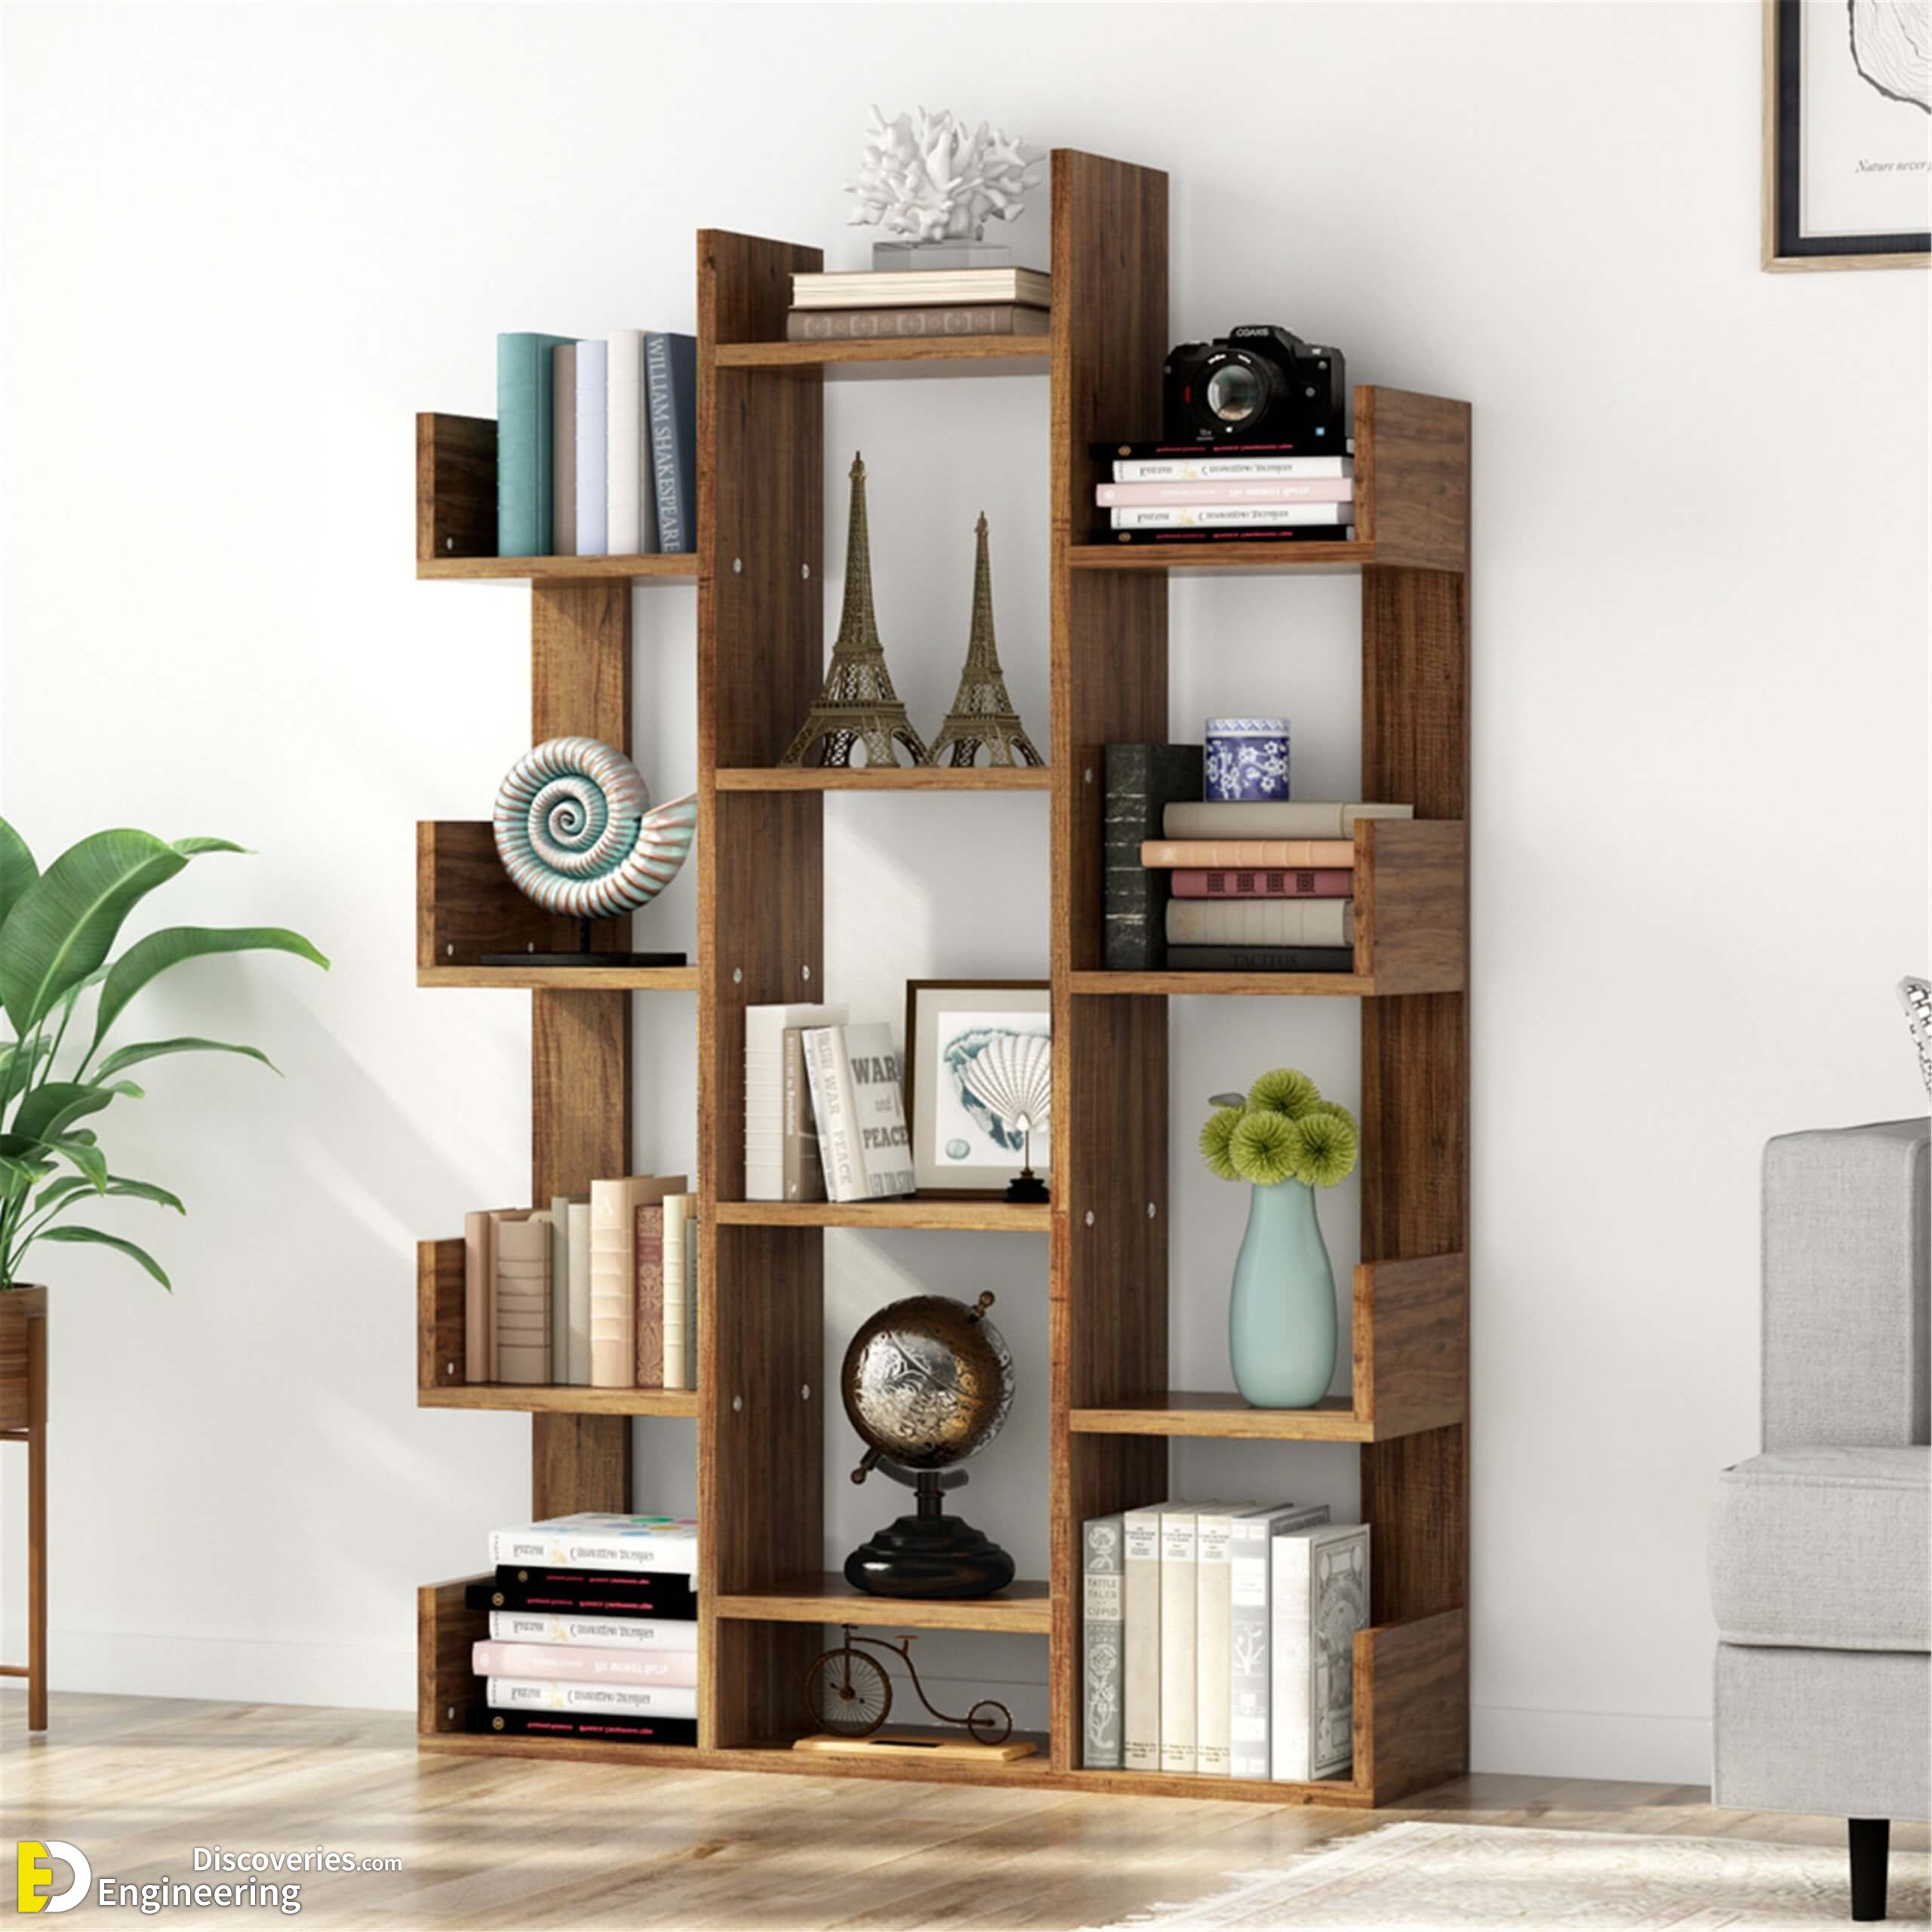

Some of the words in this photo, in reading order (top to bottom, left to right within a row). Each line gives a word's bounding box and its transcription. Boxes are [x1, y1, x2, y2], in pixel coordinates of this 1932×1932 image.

[1855, 159, 1894, 174] Nature
[1897, 161, 1927, 171] never
[649, 337, 670, 421] WILLIAM
[654, 426, 680, 552] SHAKESPEARE
[1230, 953, 1297, 967] TACITUS
[851, 1057, 900, 1085] WAR
[875, 1097, 892, 1112] and
[825, 1075, 841, 1115] WAR
[833, 1131, 852, 1185] PEACE
[863, 1125, 909, 1149] PEACE
